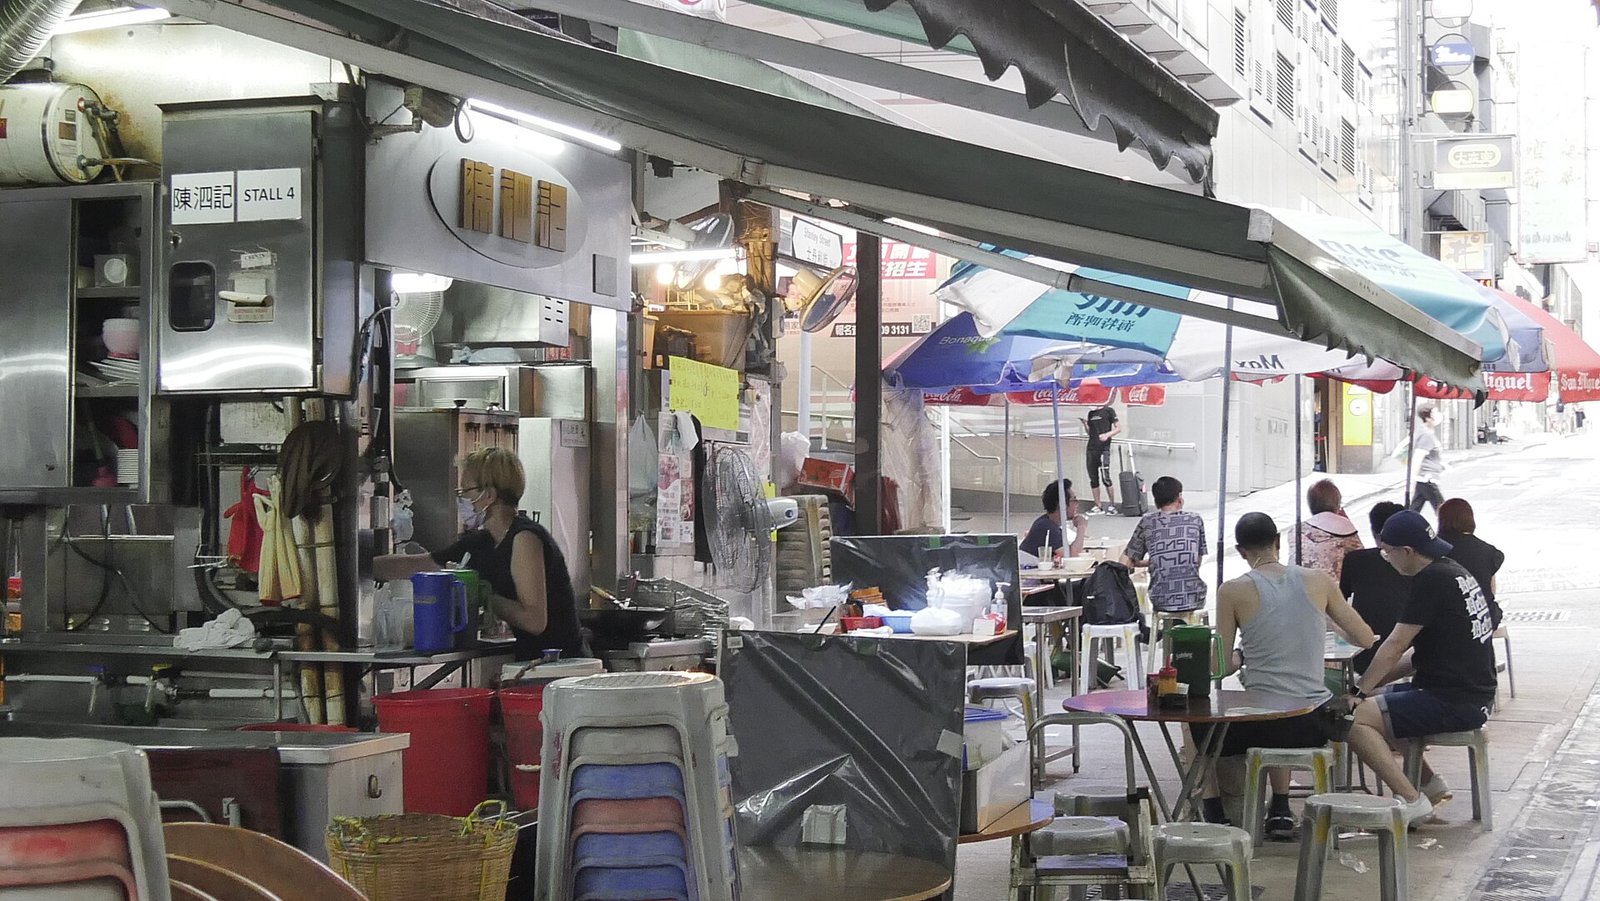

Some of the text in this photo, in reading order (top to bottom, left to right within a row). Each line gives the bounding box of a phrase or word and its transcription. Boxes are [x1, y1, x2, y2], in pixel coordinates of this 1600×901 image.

[173, 185, 233, 211] 陳泗記
[244, 187, 295, 202] STALL 4
[891, 325, 910, 335] 3131
[1577, 371, 1600, 392] Migue
[1033, 387, 1080, 402] CocaCola
